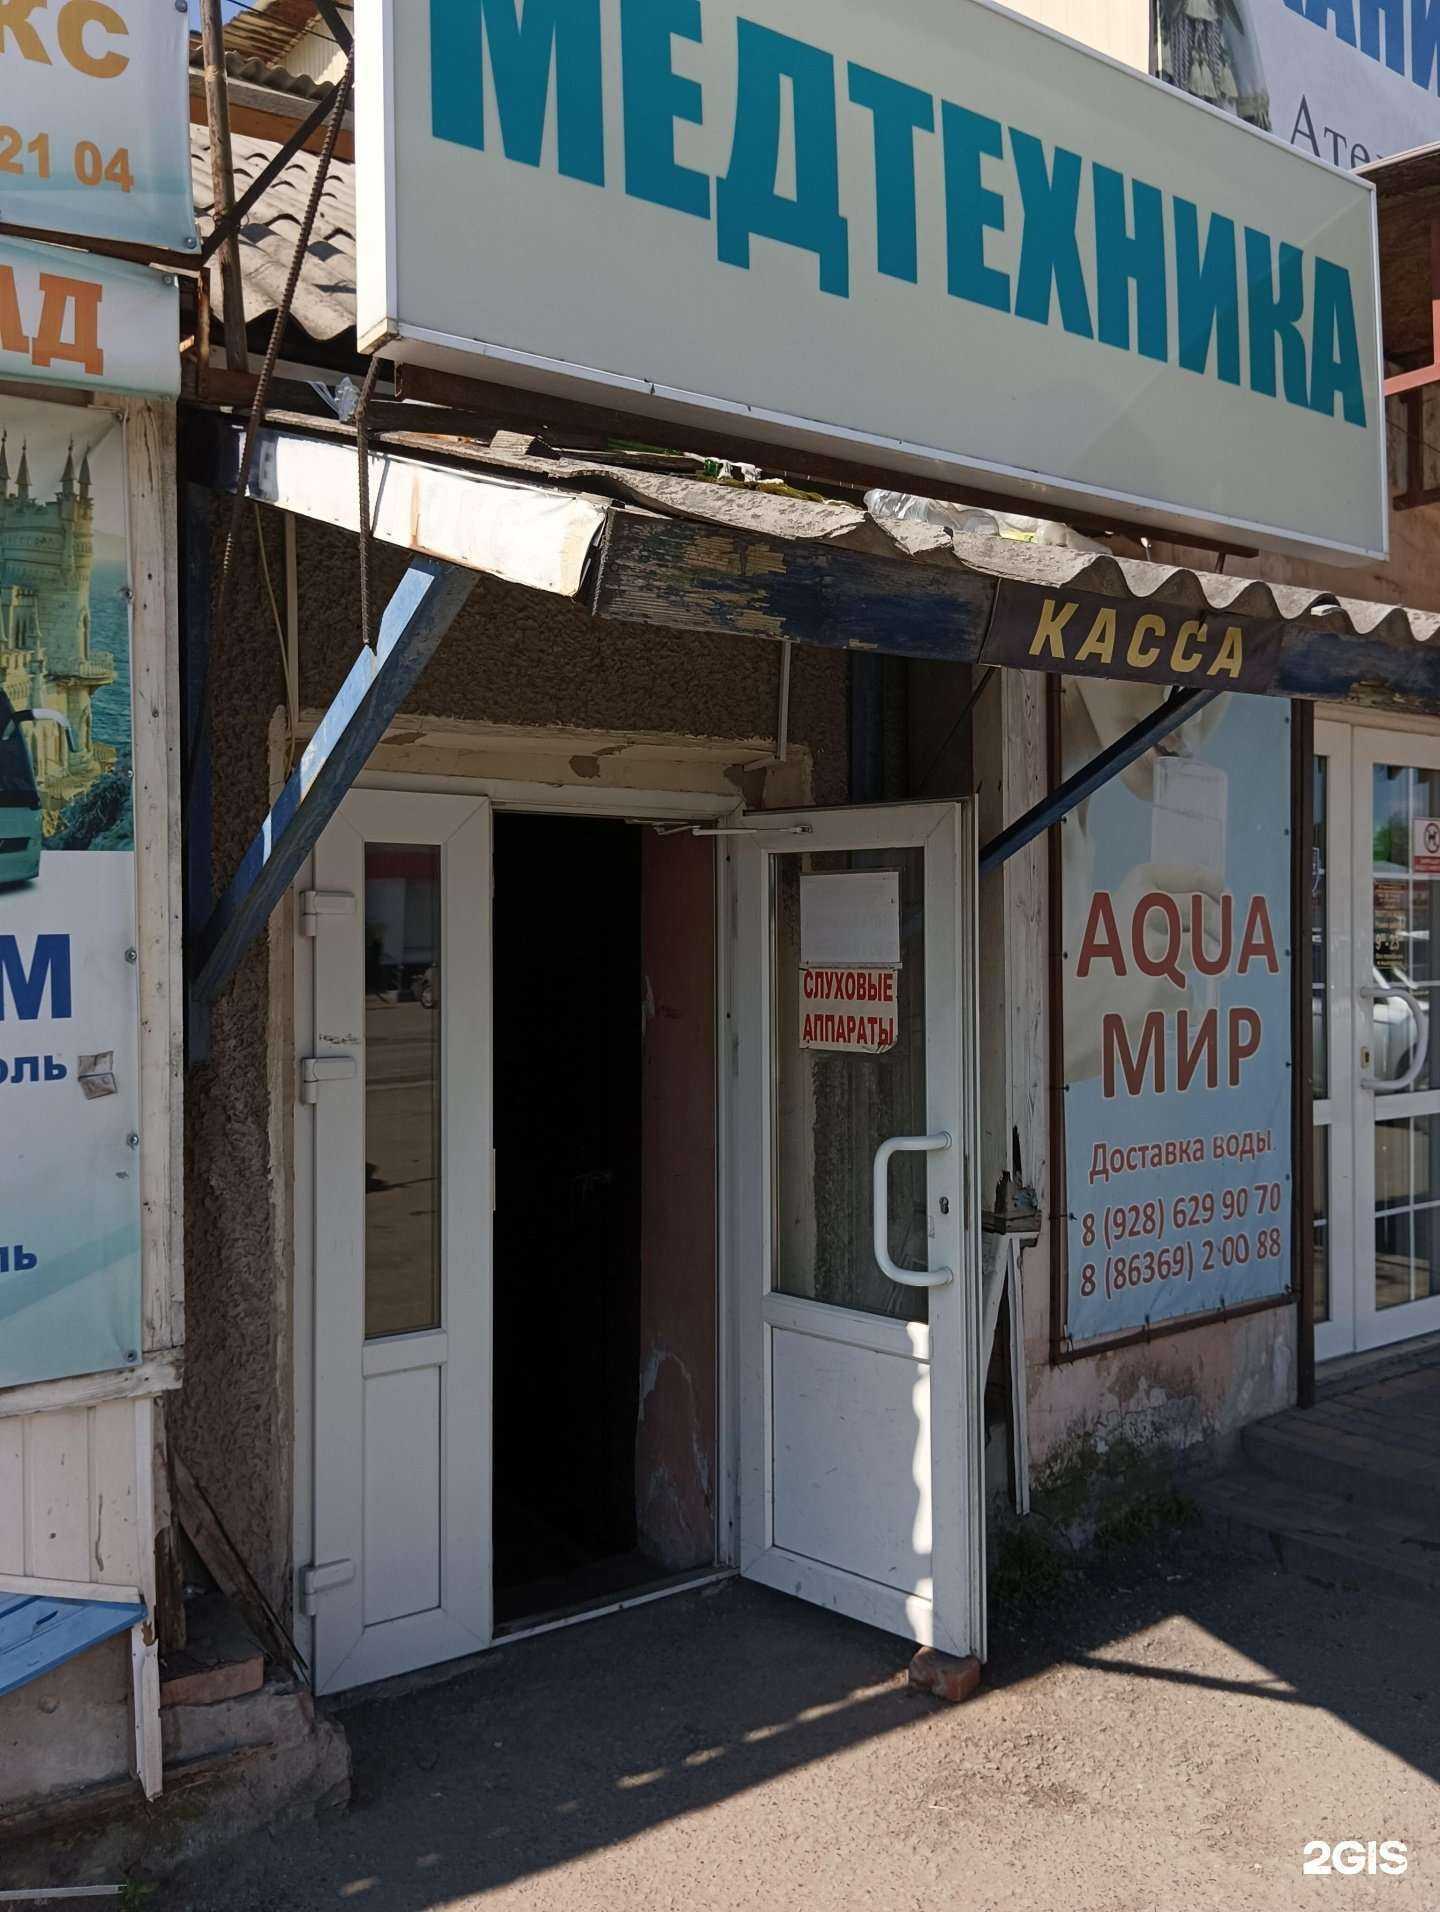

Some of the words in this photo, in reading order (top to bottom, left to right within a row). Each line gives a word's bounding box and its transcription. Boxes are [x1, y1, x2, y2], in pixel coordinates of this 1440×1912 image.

[0, 125, 49, 178] 21
[75, 141, 134, 193] 04
[1290, 94, 1383, 169] Ате
[430, 0, 1367, 428] МЕДТЕХНИКА
[1028, 599, 1243, 679] КАССА
[1076, 892, 1280, 989] AQUA
[803, 970, 894, 1002] СЛУХОВЫЕ
[802, 1013, 895, 1046] АППАРАТЫ
[1102, 1007, 1262, 1098] МИР
[1088, 1138, 1205, 1185] Доставка
[1212, 1129, 1272, 1162] воды
[1082, 1212, 1096, 1247] 8
[1104, 1198, 1165, 1250] (928)
[1172, 1192, 1215, 1229] 629
[1221, 1187, 1248, 1220] 90
[1253, 1182, 1281, 1214] 70
[1080, 1263, 1096, 1297] 8
[1105, 1241, 1194, 1300] (86369)
[1202, 1239, 1215, 1271] 2
[1221, 1232, 1249, 1266] 00
[1256, 1227, 1281, 1260] 88
